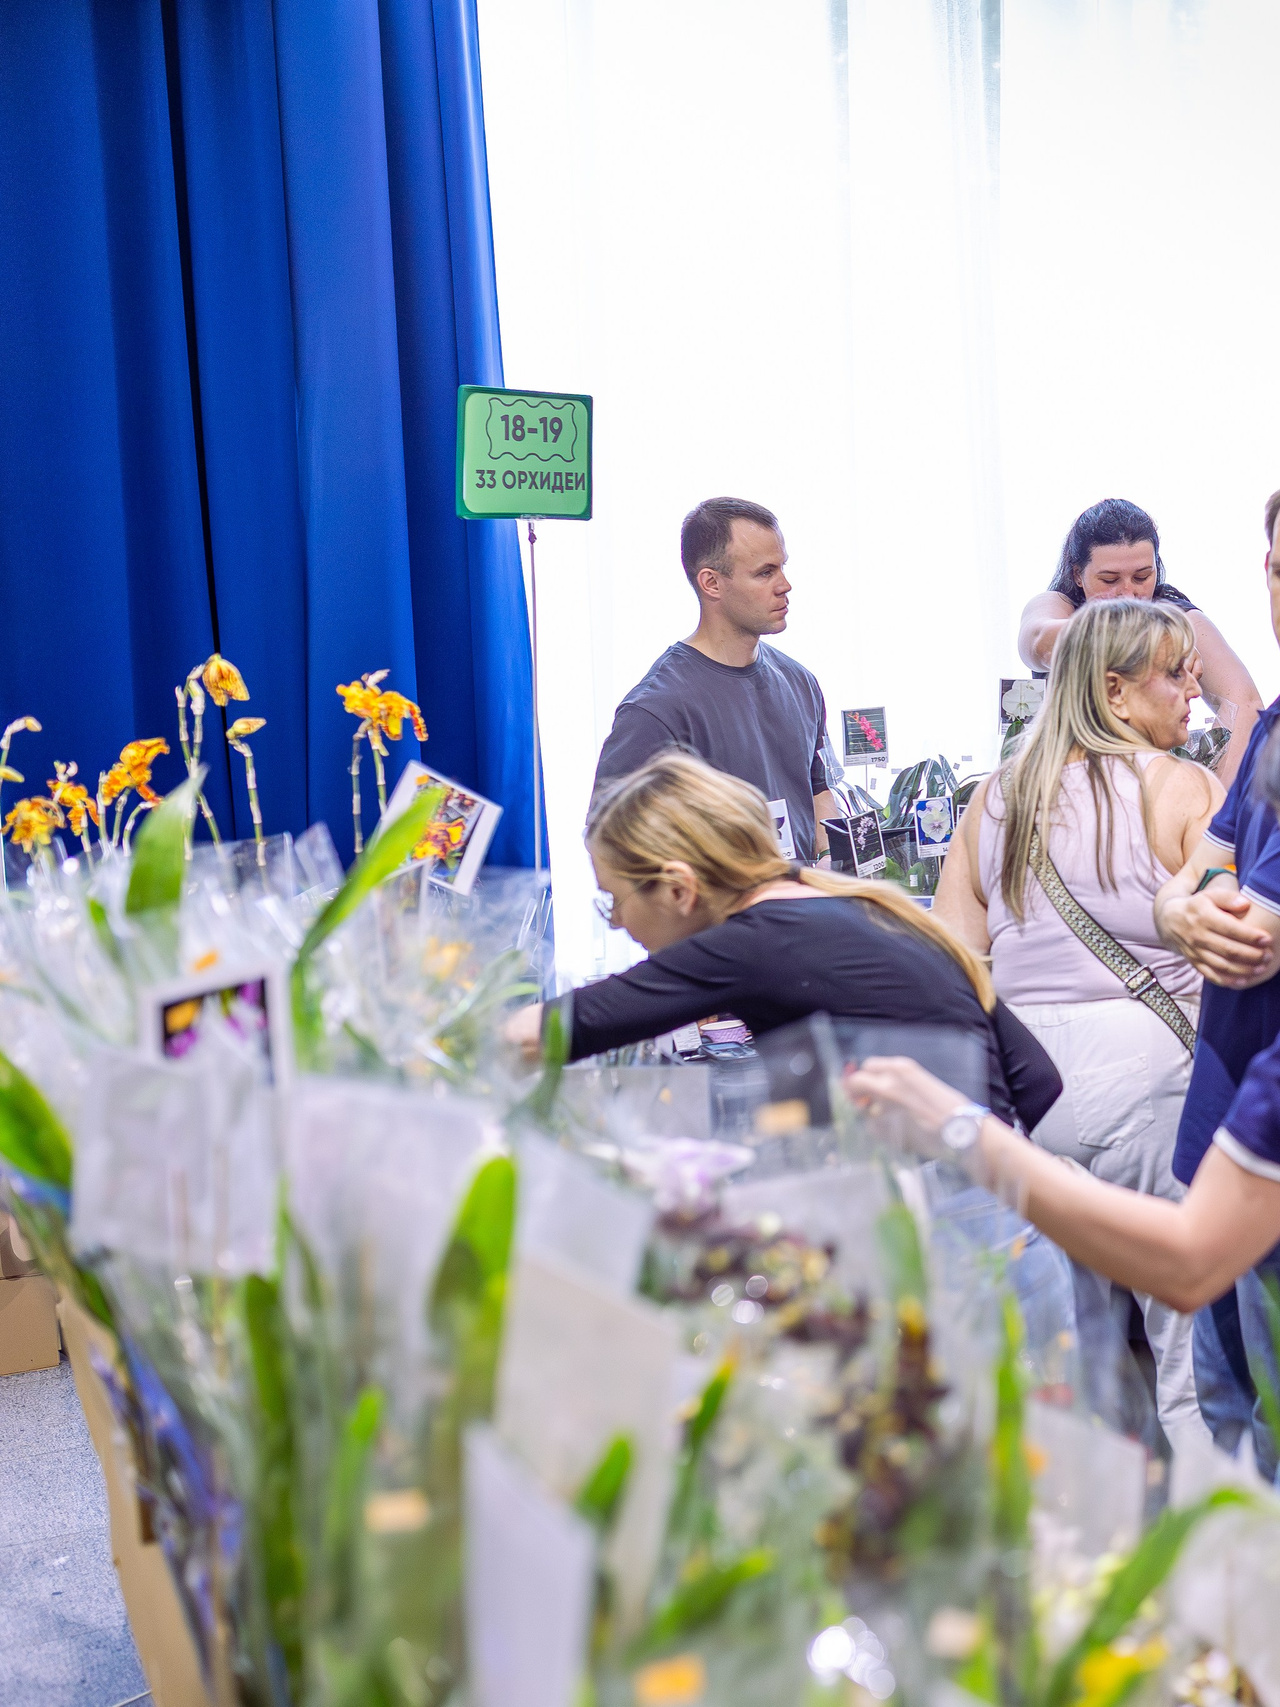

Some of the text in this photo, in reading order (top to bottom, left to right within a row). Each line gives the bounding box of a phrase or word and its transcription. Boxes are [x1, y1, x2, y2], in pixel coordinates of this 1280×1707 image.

[500, 414, 563, 443] 18-19
[475, 469, 586, 494] 33 ОРХИДЕИ
